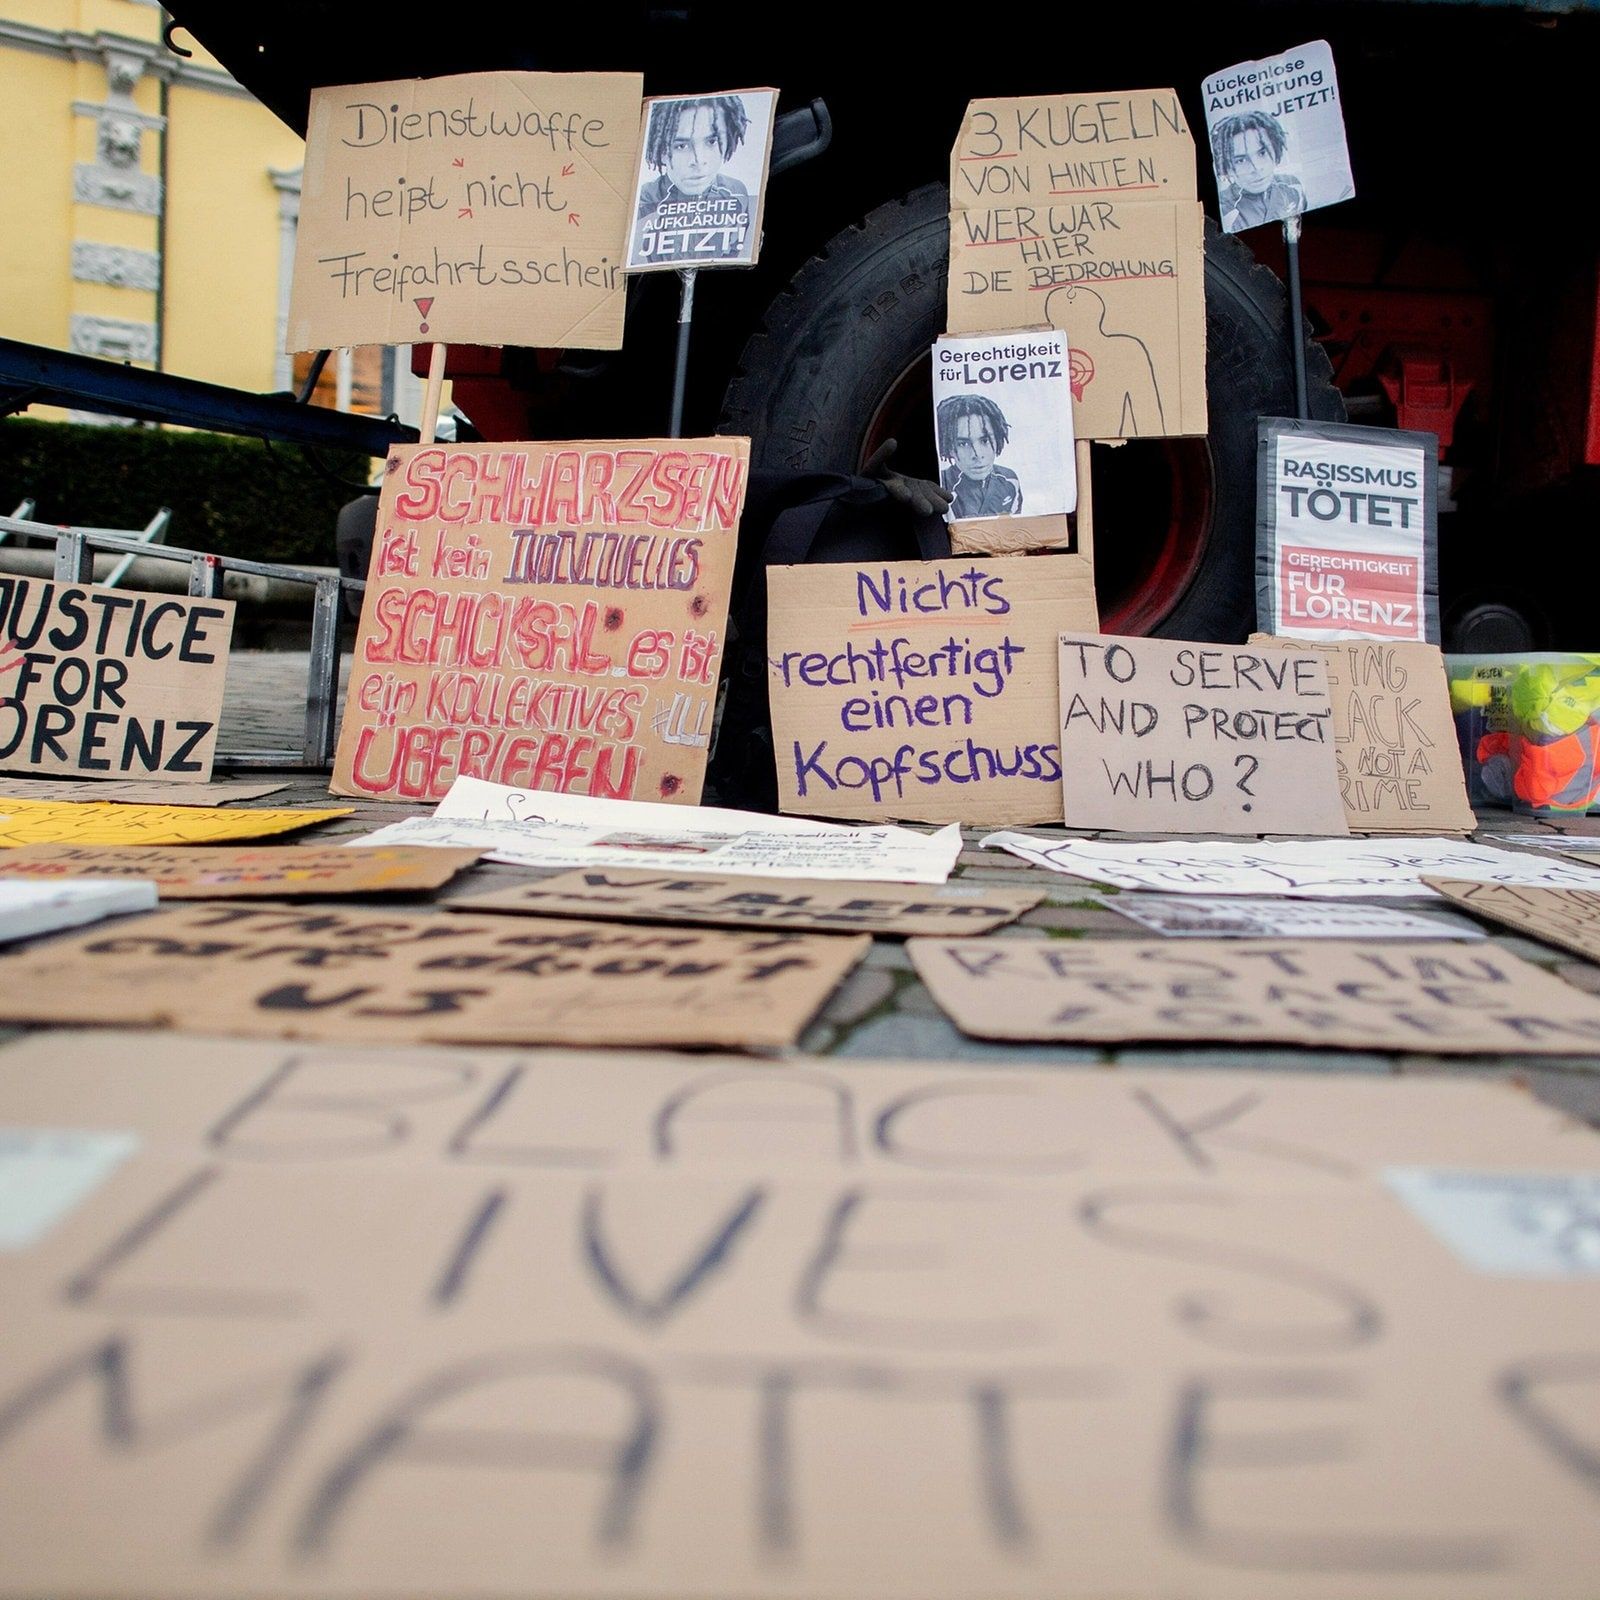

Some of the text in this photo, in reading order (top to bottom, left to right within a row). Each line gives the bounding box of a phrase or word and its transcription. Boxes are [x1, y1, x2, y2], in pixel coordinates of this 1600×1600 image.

[1206, 59, 1305, 95] Lückenlose
[1209, 70, 1323, 112] Aufklärung
[1271, 86, 1336, 118] JETZT!
[341, 97, 610, 151] Dienstwaffe
[969, 97, 1187, 157] 3 KUGELN.
[960, 157, 1169, 196] VON HINTEN.
[346, 172, 568, 224] heißt nicht
[656, 199, 738, 216] GERECHTE
[638, 227, 747, 257] JETZT!
[642, 212, 749, 232] AUFKLÄRUNG
[963, 202, 1121, 243] WER WAR
[1020, 233, 1095, 264] HIER
[318, 245, 627, 302] Freifahrtsschein
[961, 260, 1175, 294] DIE BEDROHUNG
[939, 342, 1061, 363] Gerechtigkeit
[939, 360, 1063, 385] für Lorenz
[1283, 459, 1418, 489] RASISSMUS
[1281, 480, 1418, 529] TÖTET
[376, 529, 418, 578] ist
[432, 530, 493, 580] kein
[1287, 552, 1412, 577] GERECHTIGKEIT
[856, 567, 1011, 616] Nichts
[1287, 566, 1346, 596] FÜR
[1289, 592, 1414, 628] LORENZ
[626, 629, 676, 679] es
[680, 629, 720, 685] ist
[781, 635, 1026, 698] rechtfertigt
[1170, 650, 1325, 697] SERVE
[15, 652, 129, 710] FOR
[359, 674, 418, 714] ein
[425, 670, 650, 744] KOLLEKTIVES
[841, 690, 973, 733] einen
[1064, 693, 1159, 738] AND
[793, 737, 1062, 803] Kopfschuss
[1102, 757, 1214, 803] WHO
[1357, 746, 1406, 780] NOT
[1407, 747, 1434, 775] A
[32, 816, 164, 830] FÜR
[944, 945, 1510, 985] REST IN
[204, 1053, 1365, 1180] BLACK
[60, 1163, 1384, 1357] LIVES
